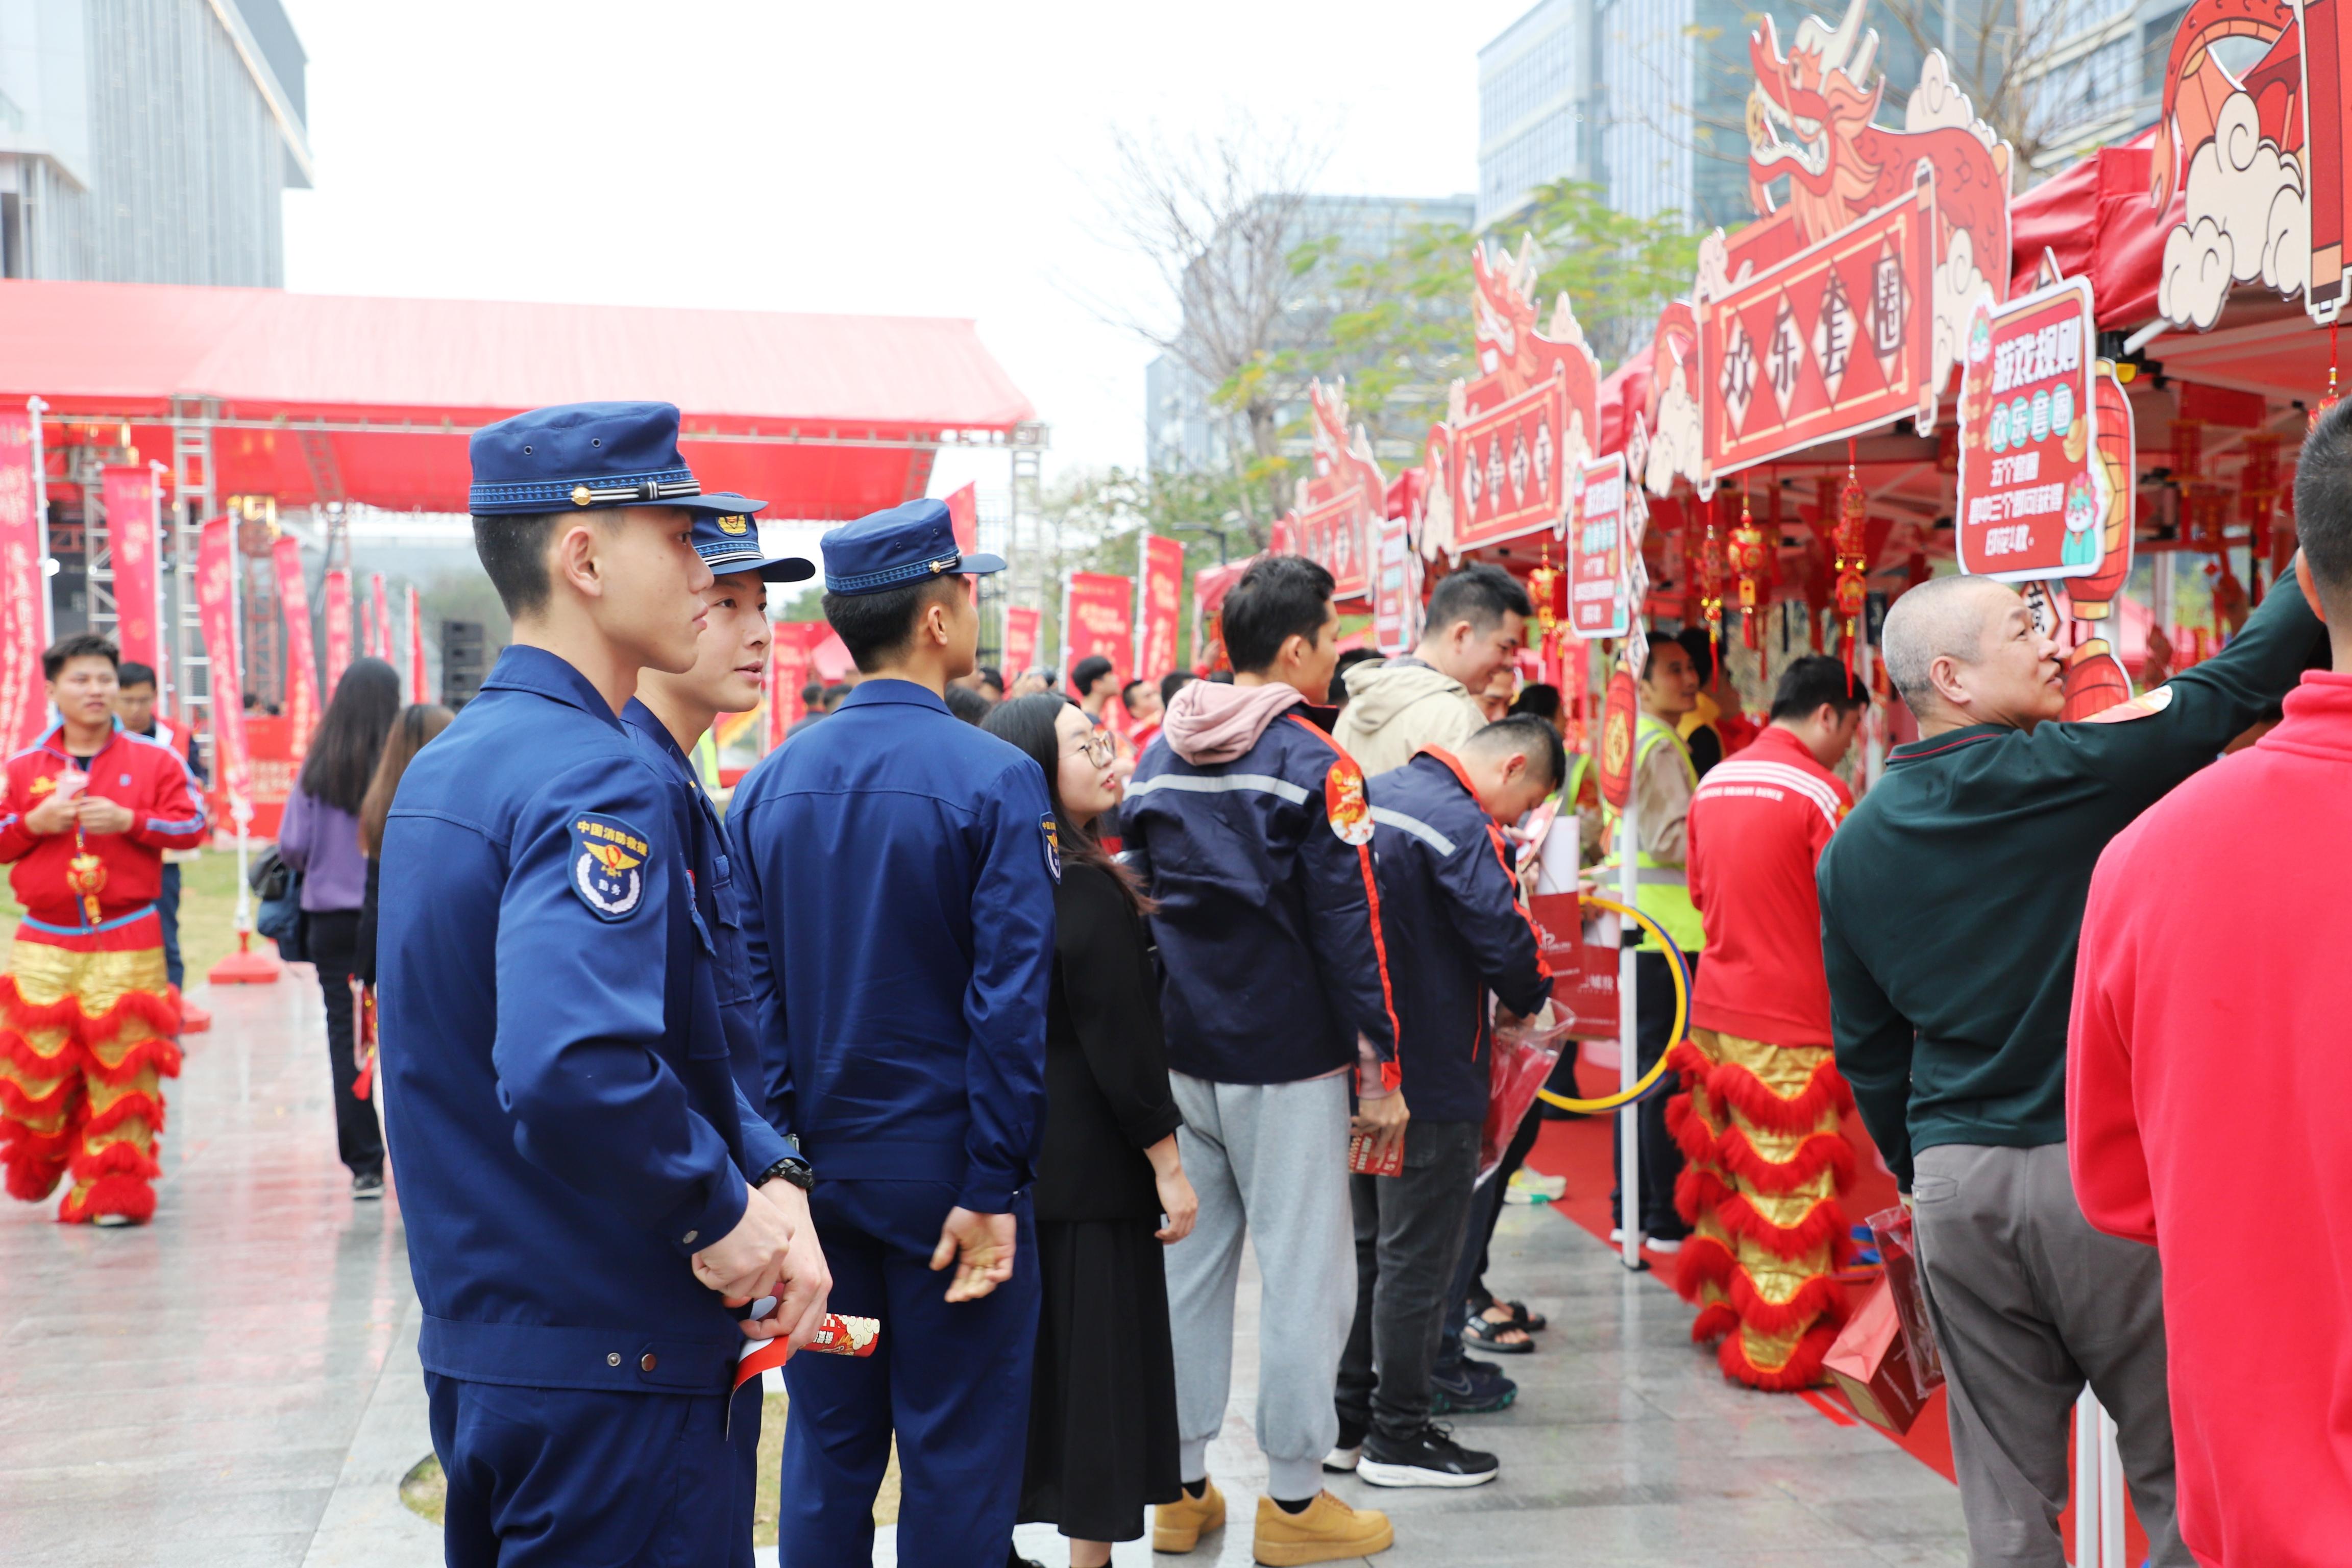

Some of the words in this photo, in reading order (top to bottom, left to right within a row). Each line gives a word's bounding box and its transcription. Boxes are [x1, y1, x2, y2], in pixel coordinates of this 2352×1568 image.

[1724, 254, 1905, 407] 欢乐套圈
[1992, 315, 2081, 395] 游戏规则
[1992, 387, 2072, 446] 欢乐套圈
[1990, 451, 2040, 487] 五个套圈
[577, 820, 648, 857] 中国消防救援
